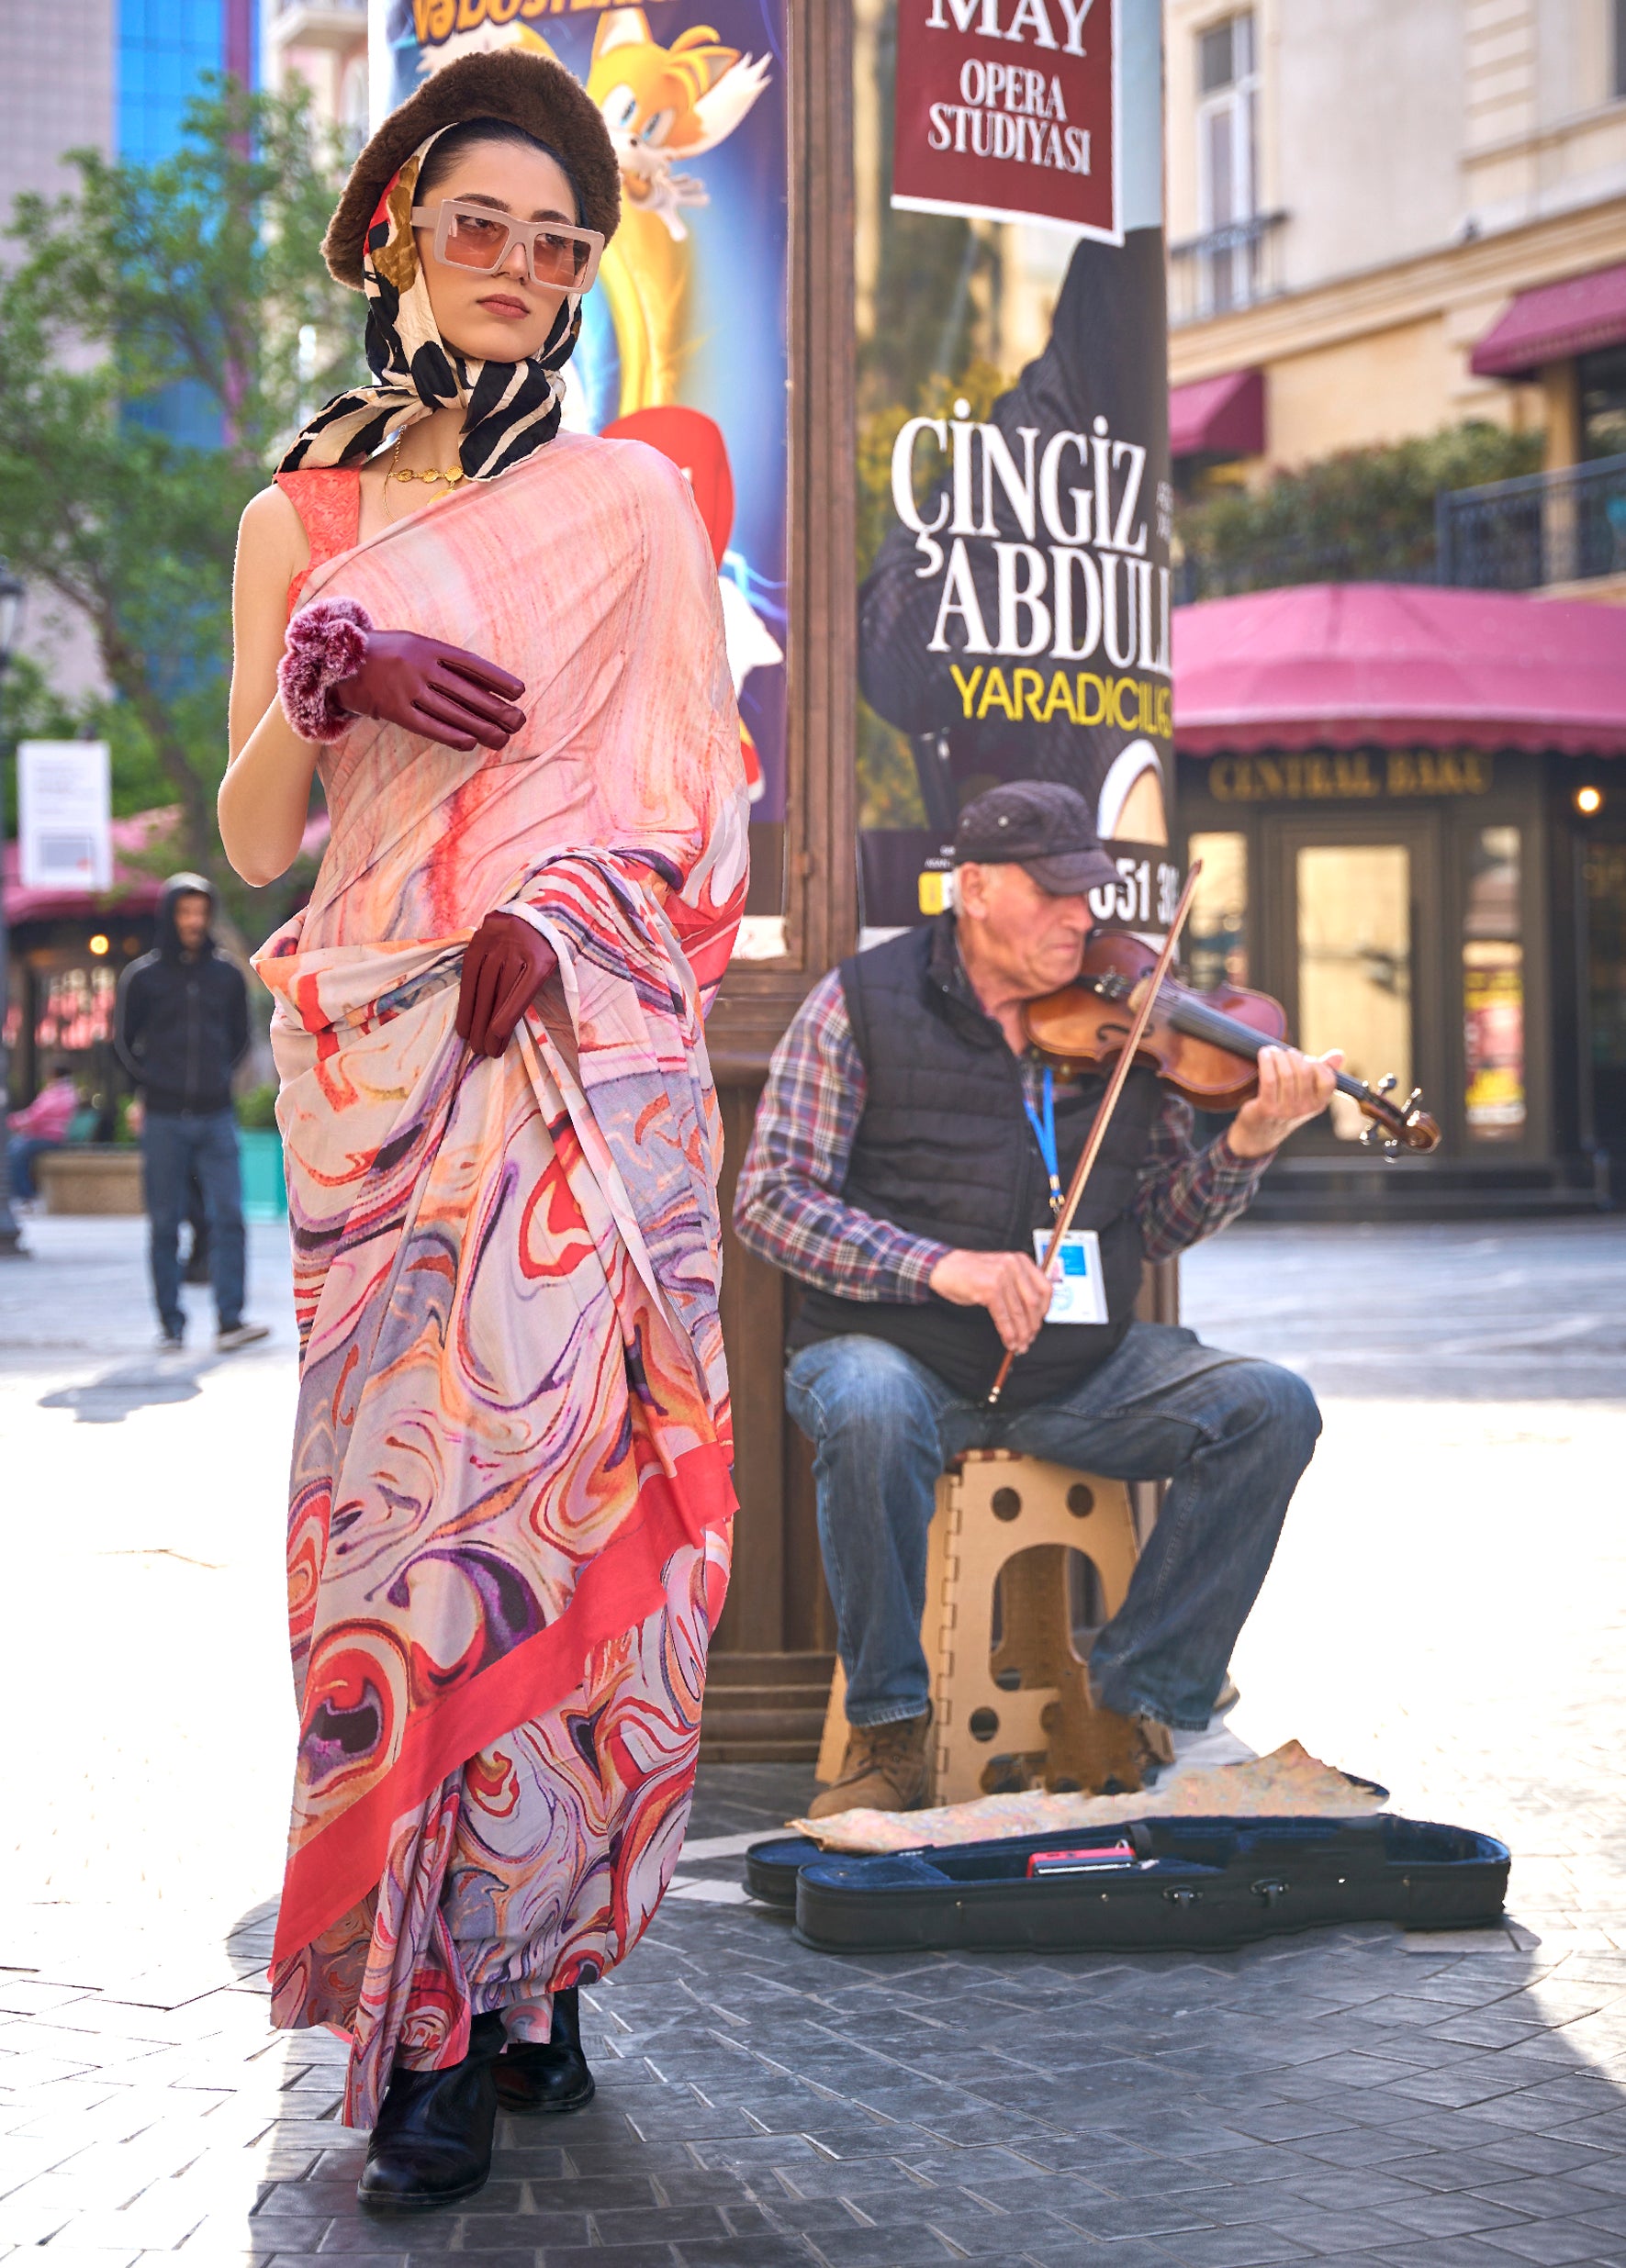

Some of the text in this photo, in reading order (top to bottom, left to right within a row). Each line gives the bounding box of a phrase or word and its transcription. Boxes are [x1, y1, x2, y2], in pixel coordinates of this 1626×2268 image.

[925, 0, 1087, 57] MAY
[959, 58, 1068, 122] OPERA
[927, 102, 1092, 176] STUDIYASI
[891, 397, 1147, 578] ÇİNGİZ
